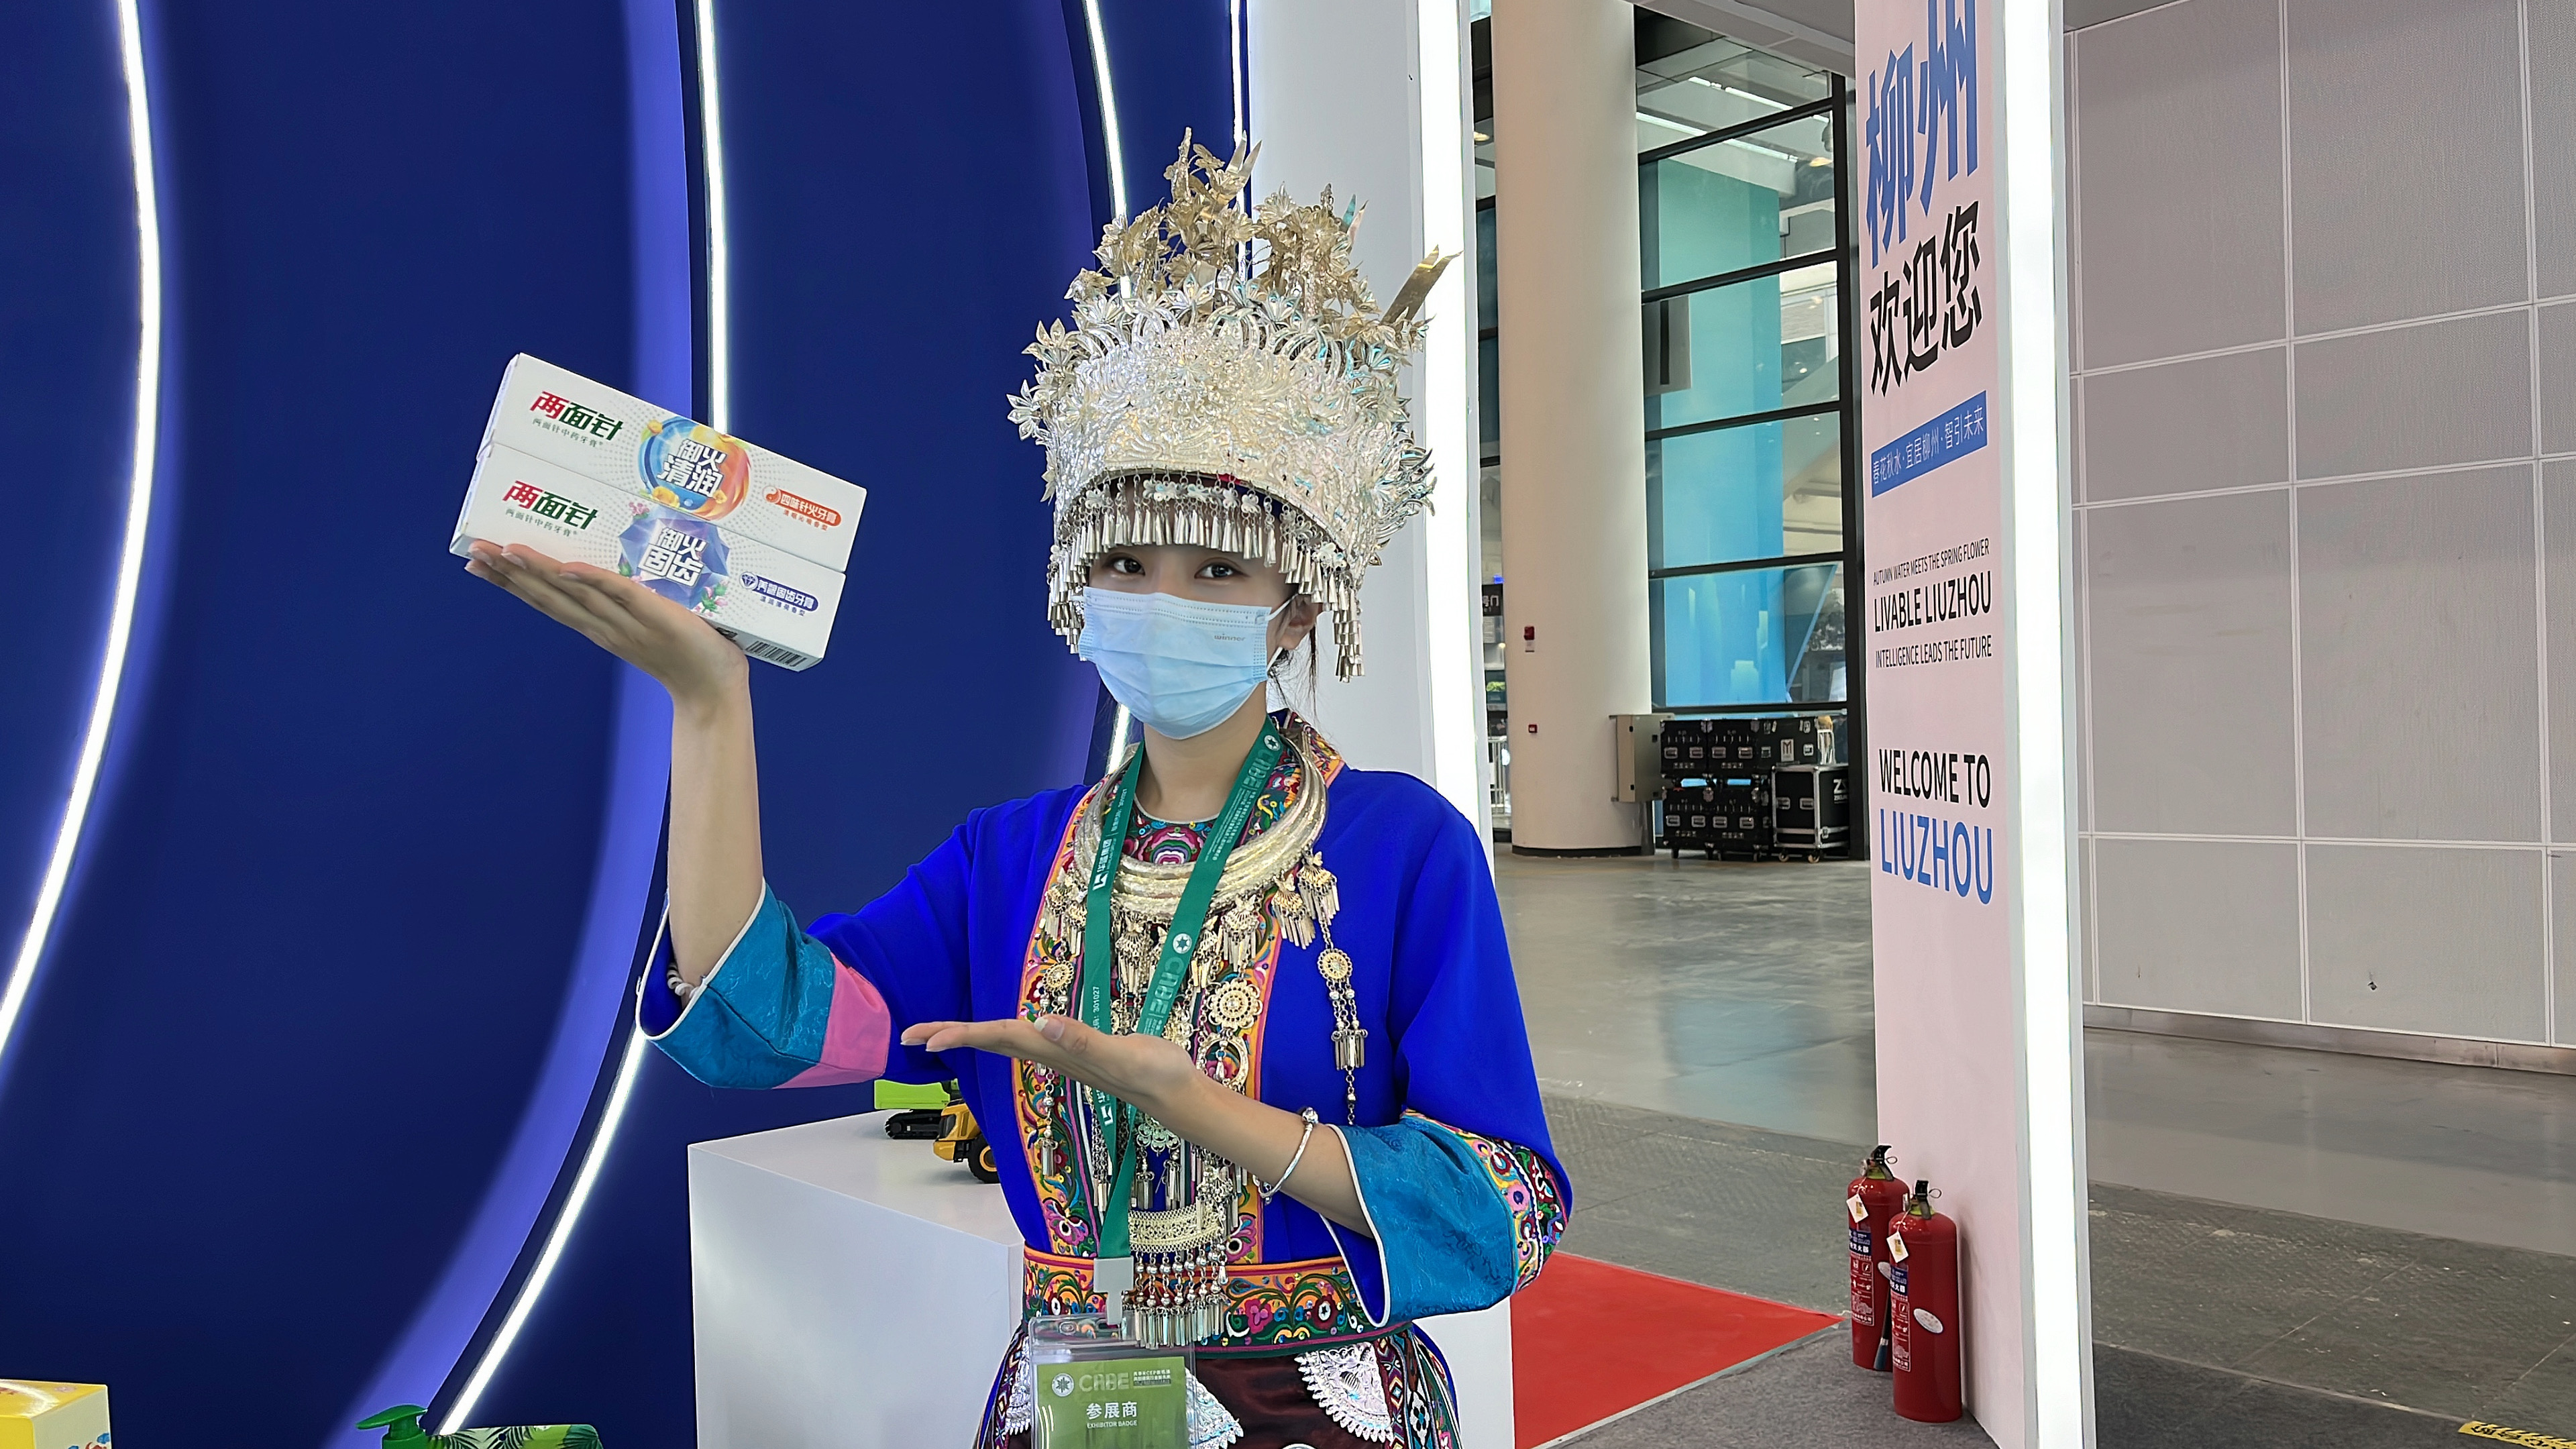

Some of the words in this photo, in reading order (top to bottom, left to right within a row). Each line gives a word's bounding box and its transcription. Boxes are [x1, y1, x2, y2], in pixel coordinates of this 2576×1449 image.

[1866, 0, 1978, 269] 柳州
[1870, 201, 1983, 397] 欢迎您
[530, 390, 624, 441] 两面针
[656, 453, 724, 499] 清润
[677, 438, 727, 472] 御火
[502, 480, 599, 530] 两面针
[638, 543, 704, 587] 固齿
[656, 527, 708, 560] 御火
[1873, 570, 1892, 586] AUTUMN
[1893, 565, 1910, 580] WATER
[1911, 557, 1928, 576] MEETS
[1929, 553, 1940, 570] THE
[1941, 545, 1962, 567] SPRING
[1964, 538, 1990, 561] FLOWER
[1874, 588, 1921, 633] LIVABLE
[1925, 571, 1991, 623] LIUZHOU
[1214, 633, 1246, 642] winner
[1876, 645, 1919, 668] INTELLIGENCE
[1921, 641, 1942, 663] LEADS
[1943, 641, 1959, 661] THE
[1960, 635, 1992, 659] FUTURE
[1879, 749, 1960, 804] WELCOME
[1964, 754, 1990, 808] TO
[1880, 809, 1992, 904] LIUZHOU
[1086, 1401, 1138, 1420] 参展商
[1087, 1421, 1118, 1429] EXHIBITOR
